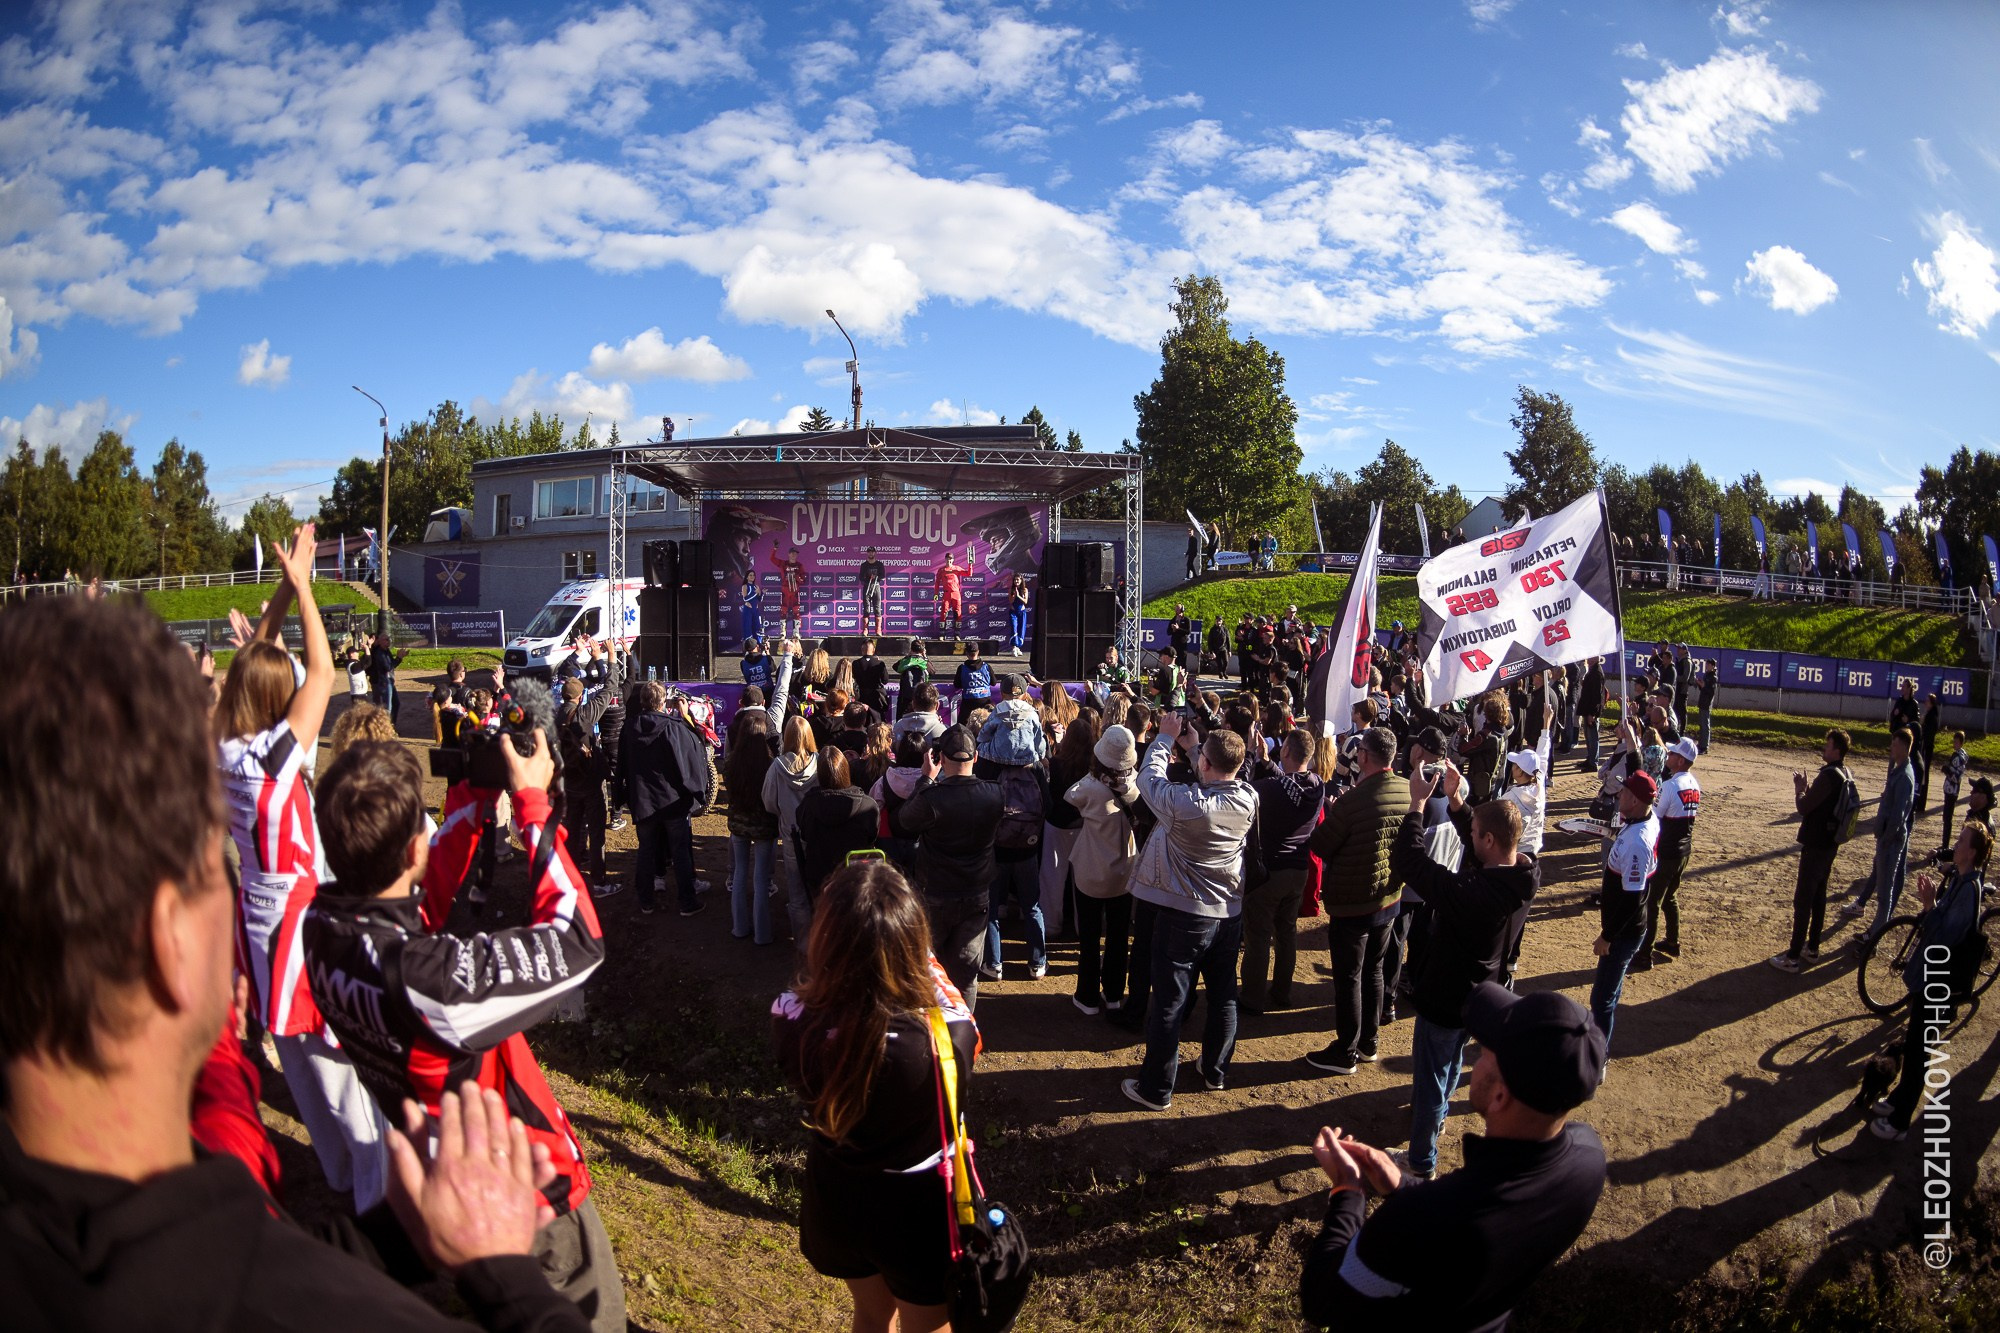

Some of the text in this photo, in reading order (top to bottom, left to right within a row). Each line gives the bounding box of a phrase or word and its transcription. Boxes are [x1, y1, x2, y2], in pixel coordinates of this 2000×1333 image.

[791, 502, 957, 547] СУПЕРКРОСС
[451, 620, 498, 630] ДОСААФ РОССИИ
[750, 673, 766, 681] 008
[1745, 663, 1771, 679] ВТБ
[1798, 667, 1823, 683] ВТБ
[1848, 671, 1872, 688] ВТБ
[1942, 680, 1964, 696] ВТБ
